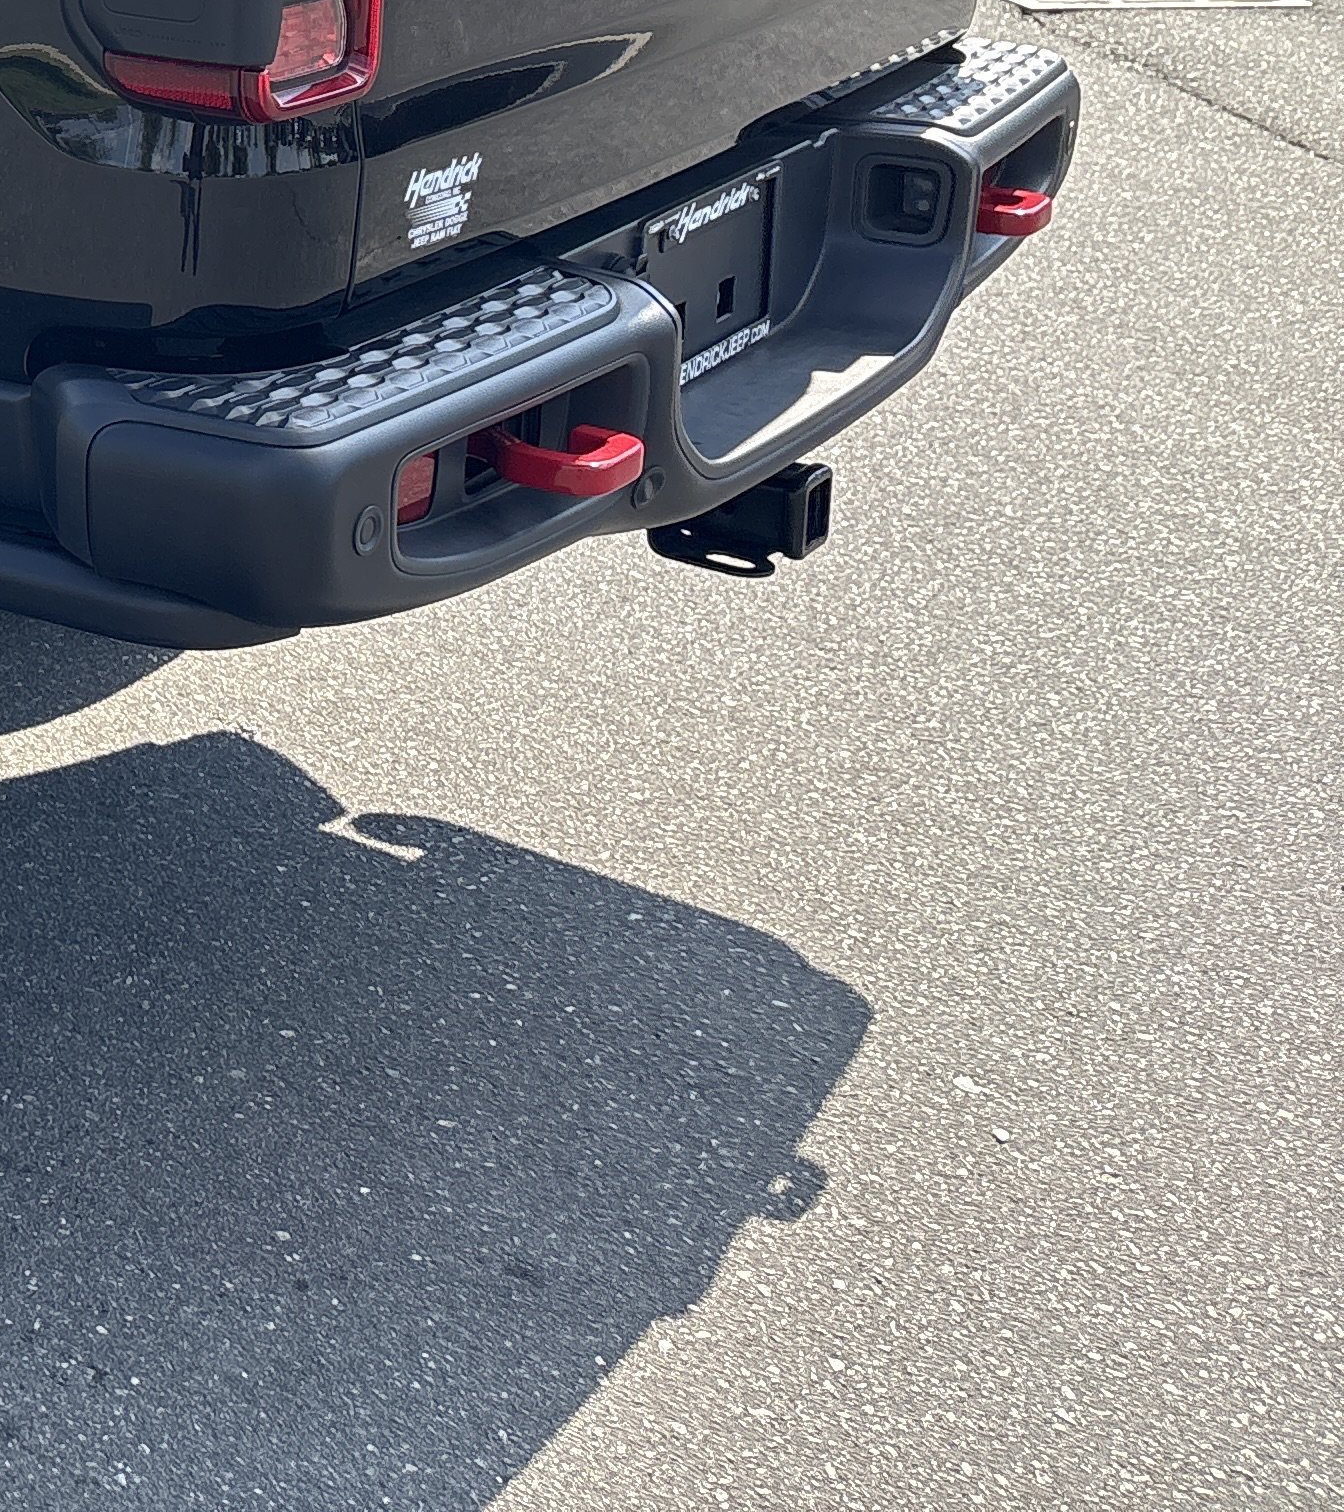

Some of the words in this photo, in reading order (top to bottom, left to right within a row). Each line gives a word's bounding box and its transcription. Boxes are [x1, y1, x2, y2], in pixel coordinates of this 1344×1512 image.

[403, 151, 483, 209] Hendrick
[407, 218, 445, 240] CHRYSLER
[444, 211, 468, 226] DODGE
[410, 234, 431, 249] JEEP
[430, 228, 446, 242] RAM
[675, 181, 753, 244] Hendrick
[678, 318, 771, 387] ENDRICKJEEP.COM
